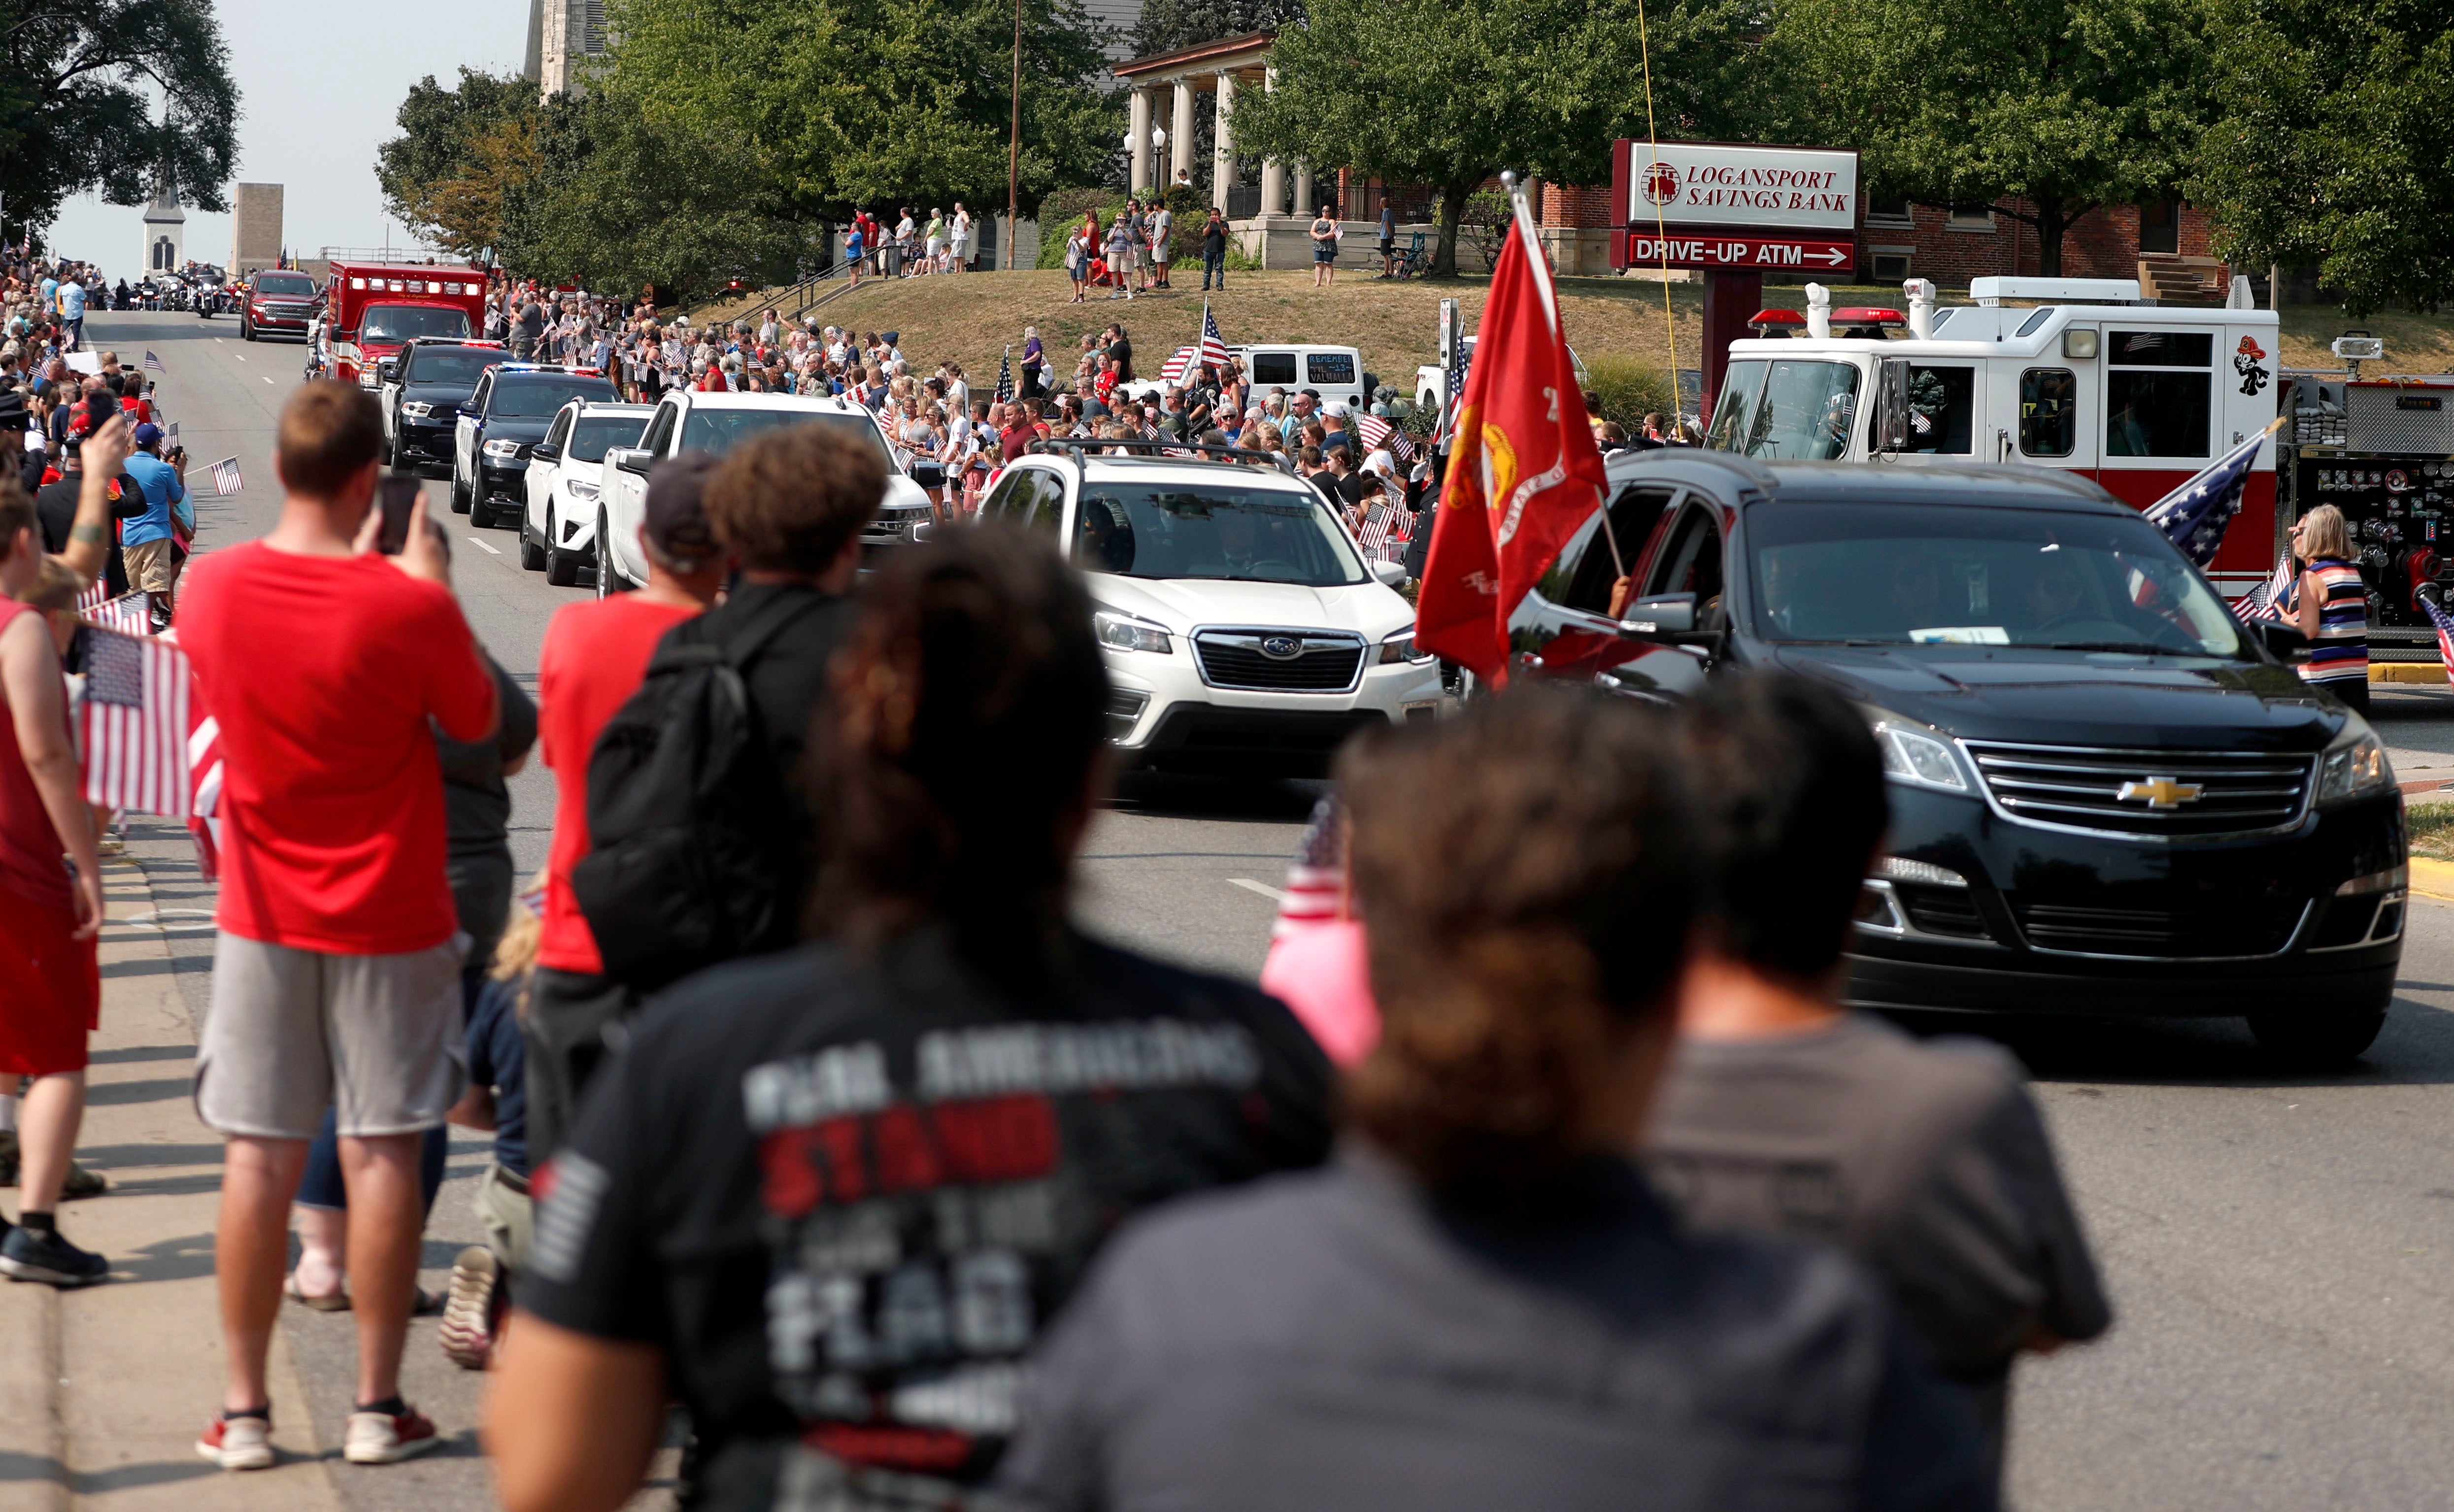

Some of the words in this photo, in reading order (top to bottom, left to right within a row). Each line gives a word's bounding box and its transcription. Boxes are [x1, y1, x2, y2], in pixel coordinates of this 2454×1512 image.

[1685, 165, 1837, 189] LOGANSPORT
[1685, 187, 1782, 208] SAVINGS
[1786, 191, 1849, 211] BANK
[1637, 239, 1748, 262] DRIVE-UP
[1756, 244, 1802, 264] ATM
[1311, 373, 1353, 382] VALHALLA
